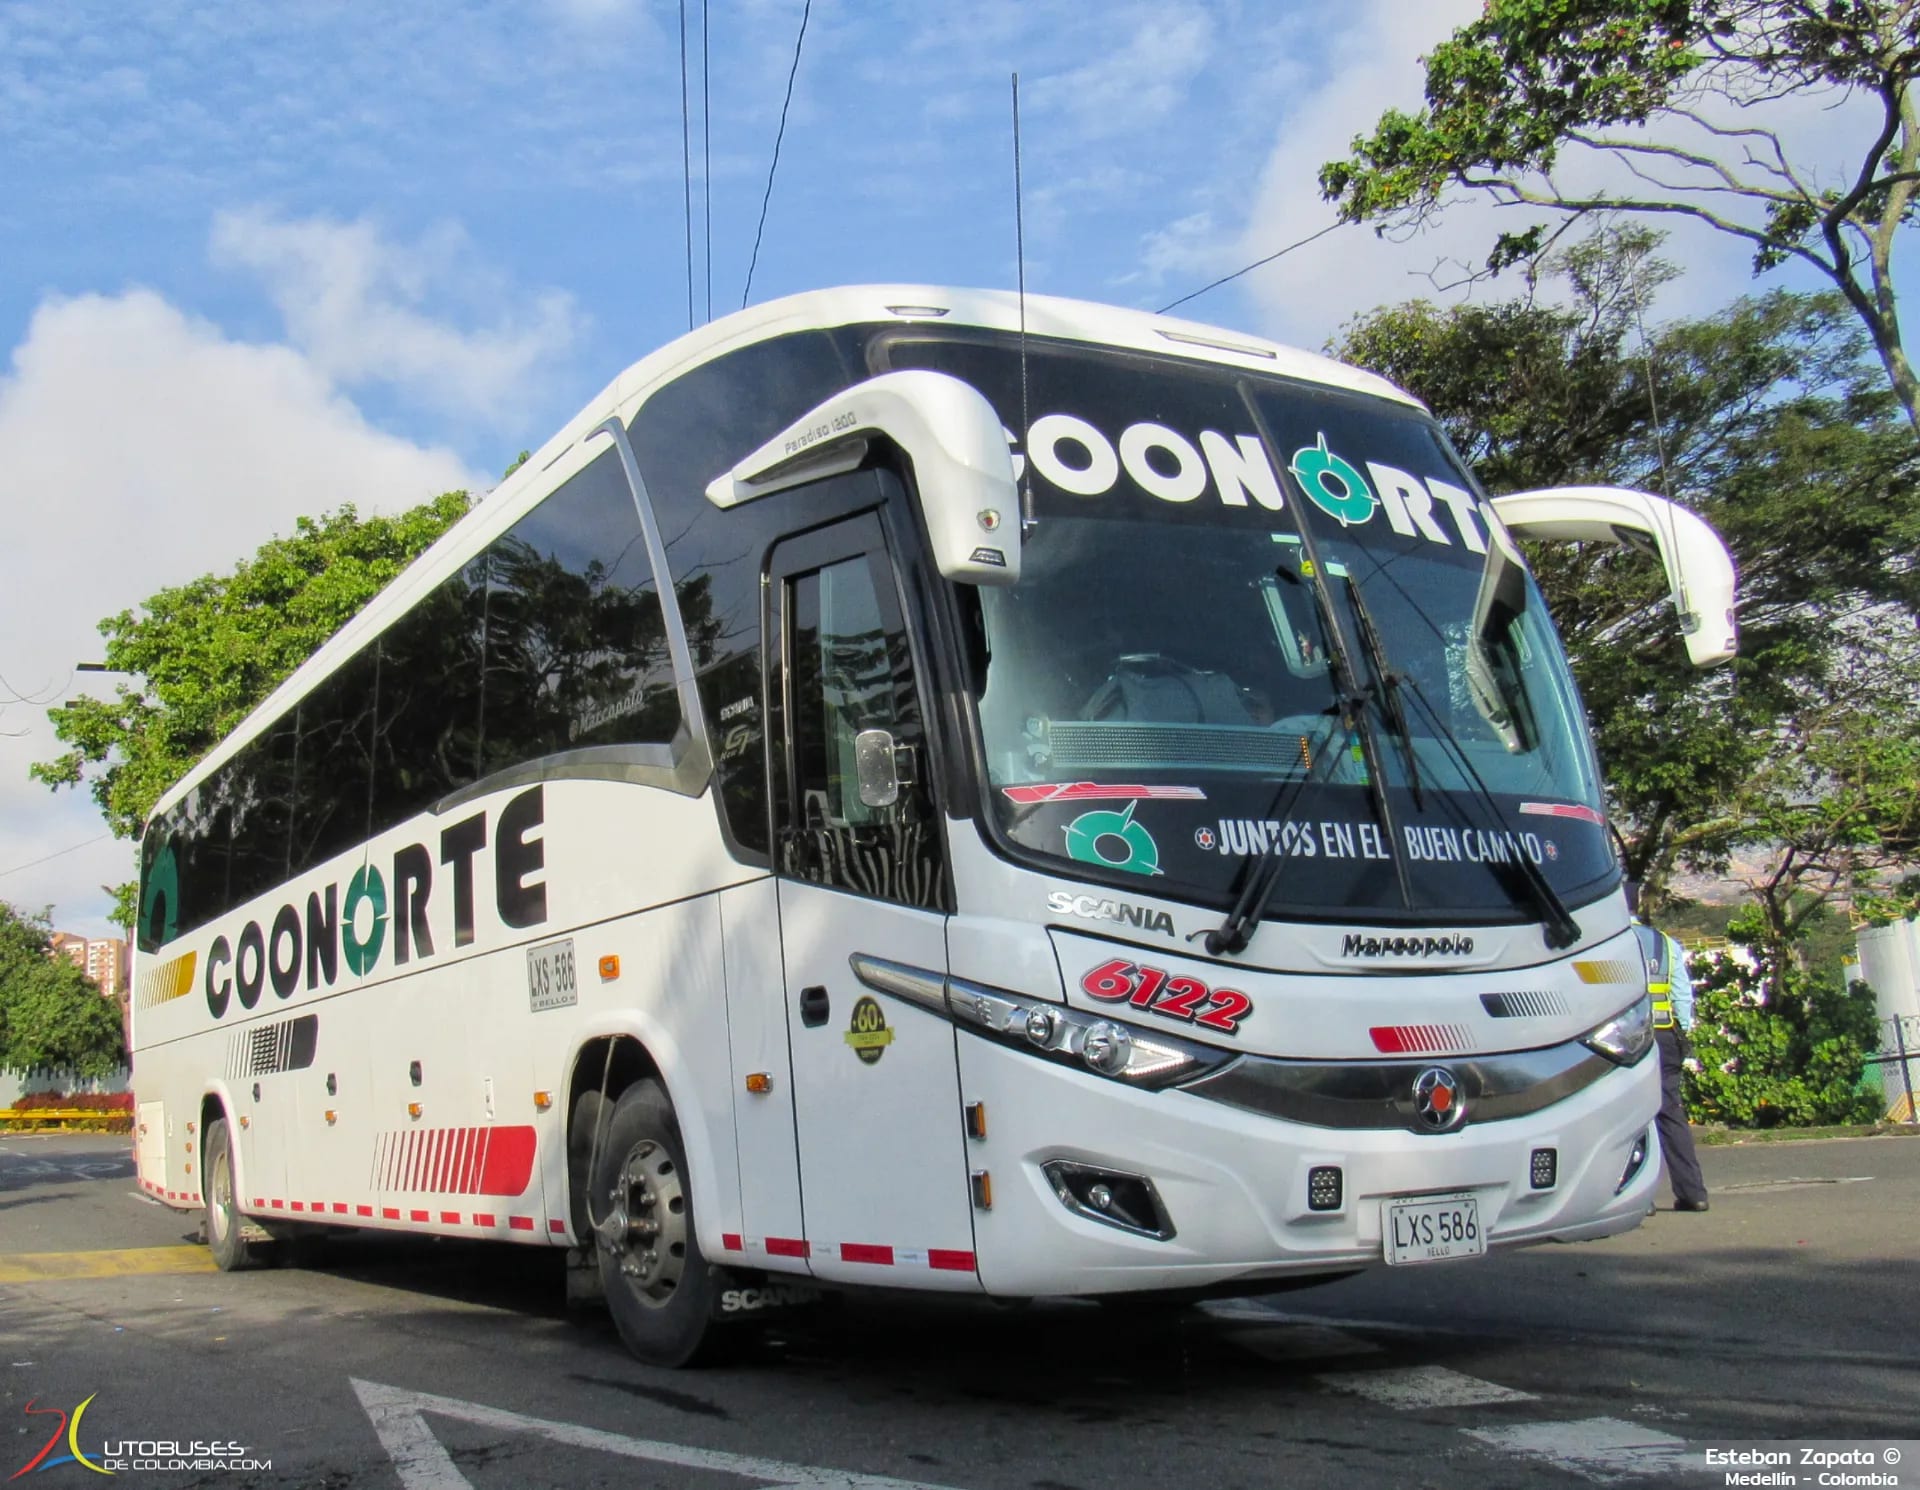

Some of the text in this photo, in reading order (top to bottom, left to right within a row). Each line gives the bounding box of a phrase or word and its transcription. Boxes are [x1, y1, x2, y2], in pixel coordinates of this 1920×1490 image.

[783, 411, 857, 455] Paradiso 1200
[1218, 819, 1316, 857] JUNTOS
[1319, 822, 1356, 858] EN
[1358, 823, 1390, 859] EL
[1403, 826, 1462, 862] BUEN
[205, 783, 547, 1020] COONORTE
[1047, 891, 1176, 938] SCANIA
[1341, 932, 1474, 958] Marcopolo
[529, 951, 575, 997] LXS 586
[539, 995, 568, 1007] BELLO
[857, 1003, 878, 1032] 60
[1081, 958, 1253, 1036] 6122
[1394, 1208, 1477, 1248] LXS 586
